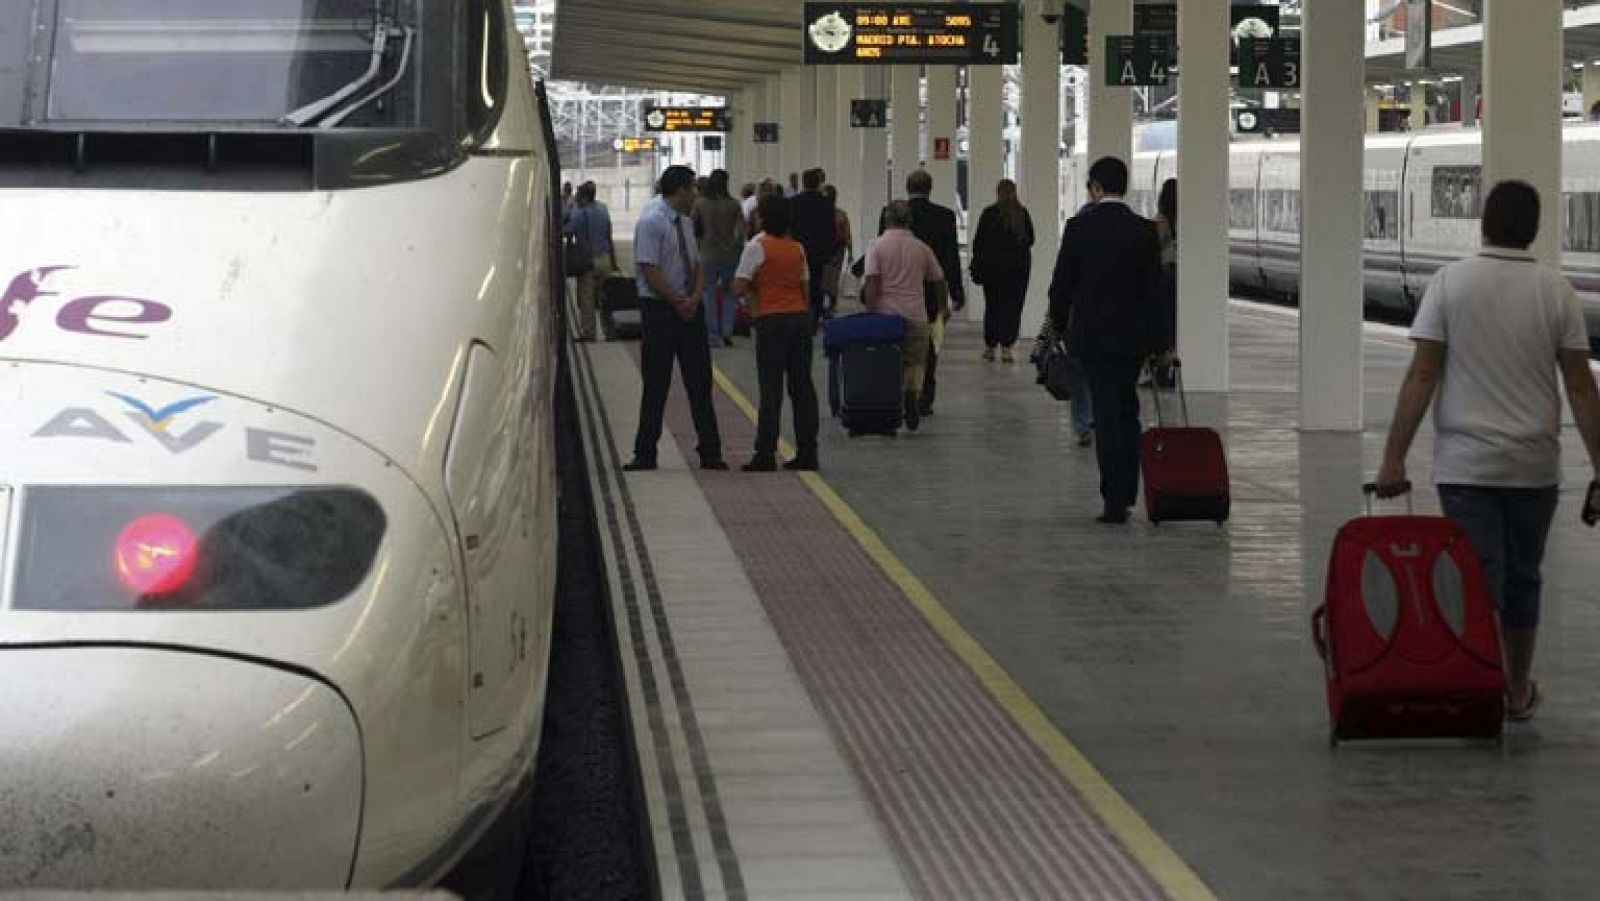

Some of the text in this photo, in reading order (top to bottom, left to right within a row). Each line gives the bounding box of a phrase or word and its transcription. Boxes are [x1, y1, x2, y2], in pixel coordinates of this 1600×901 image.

[982, 34, 1001, 57] 4
[1120, 59, 1167, 86] A 4
[1254, 62, 1298, 86] A 3
[30, 400, 318, 472] AVE
